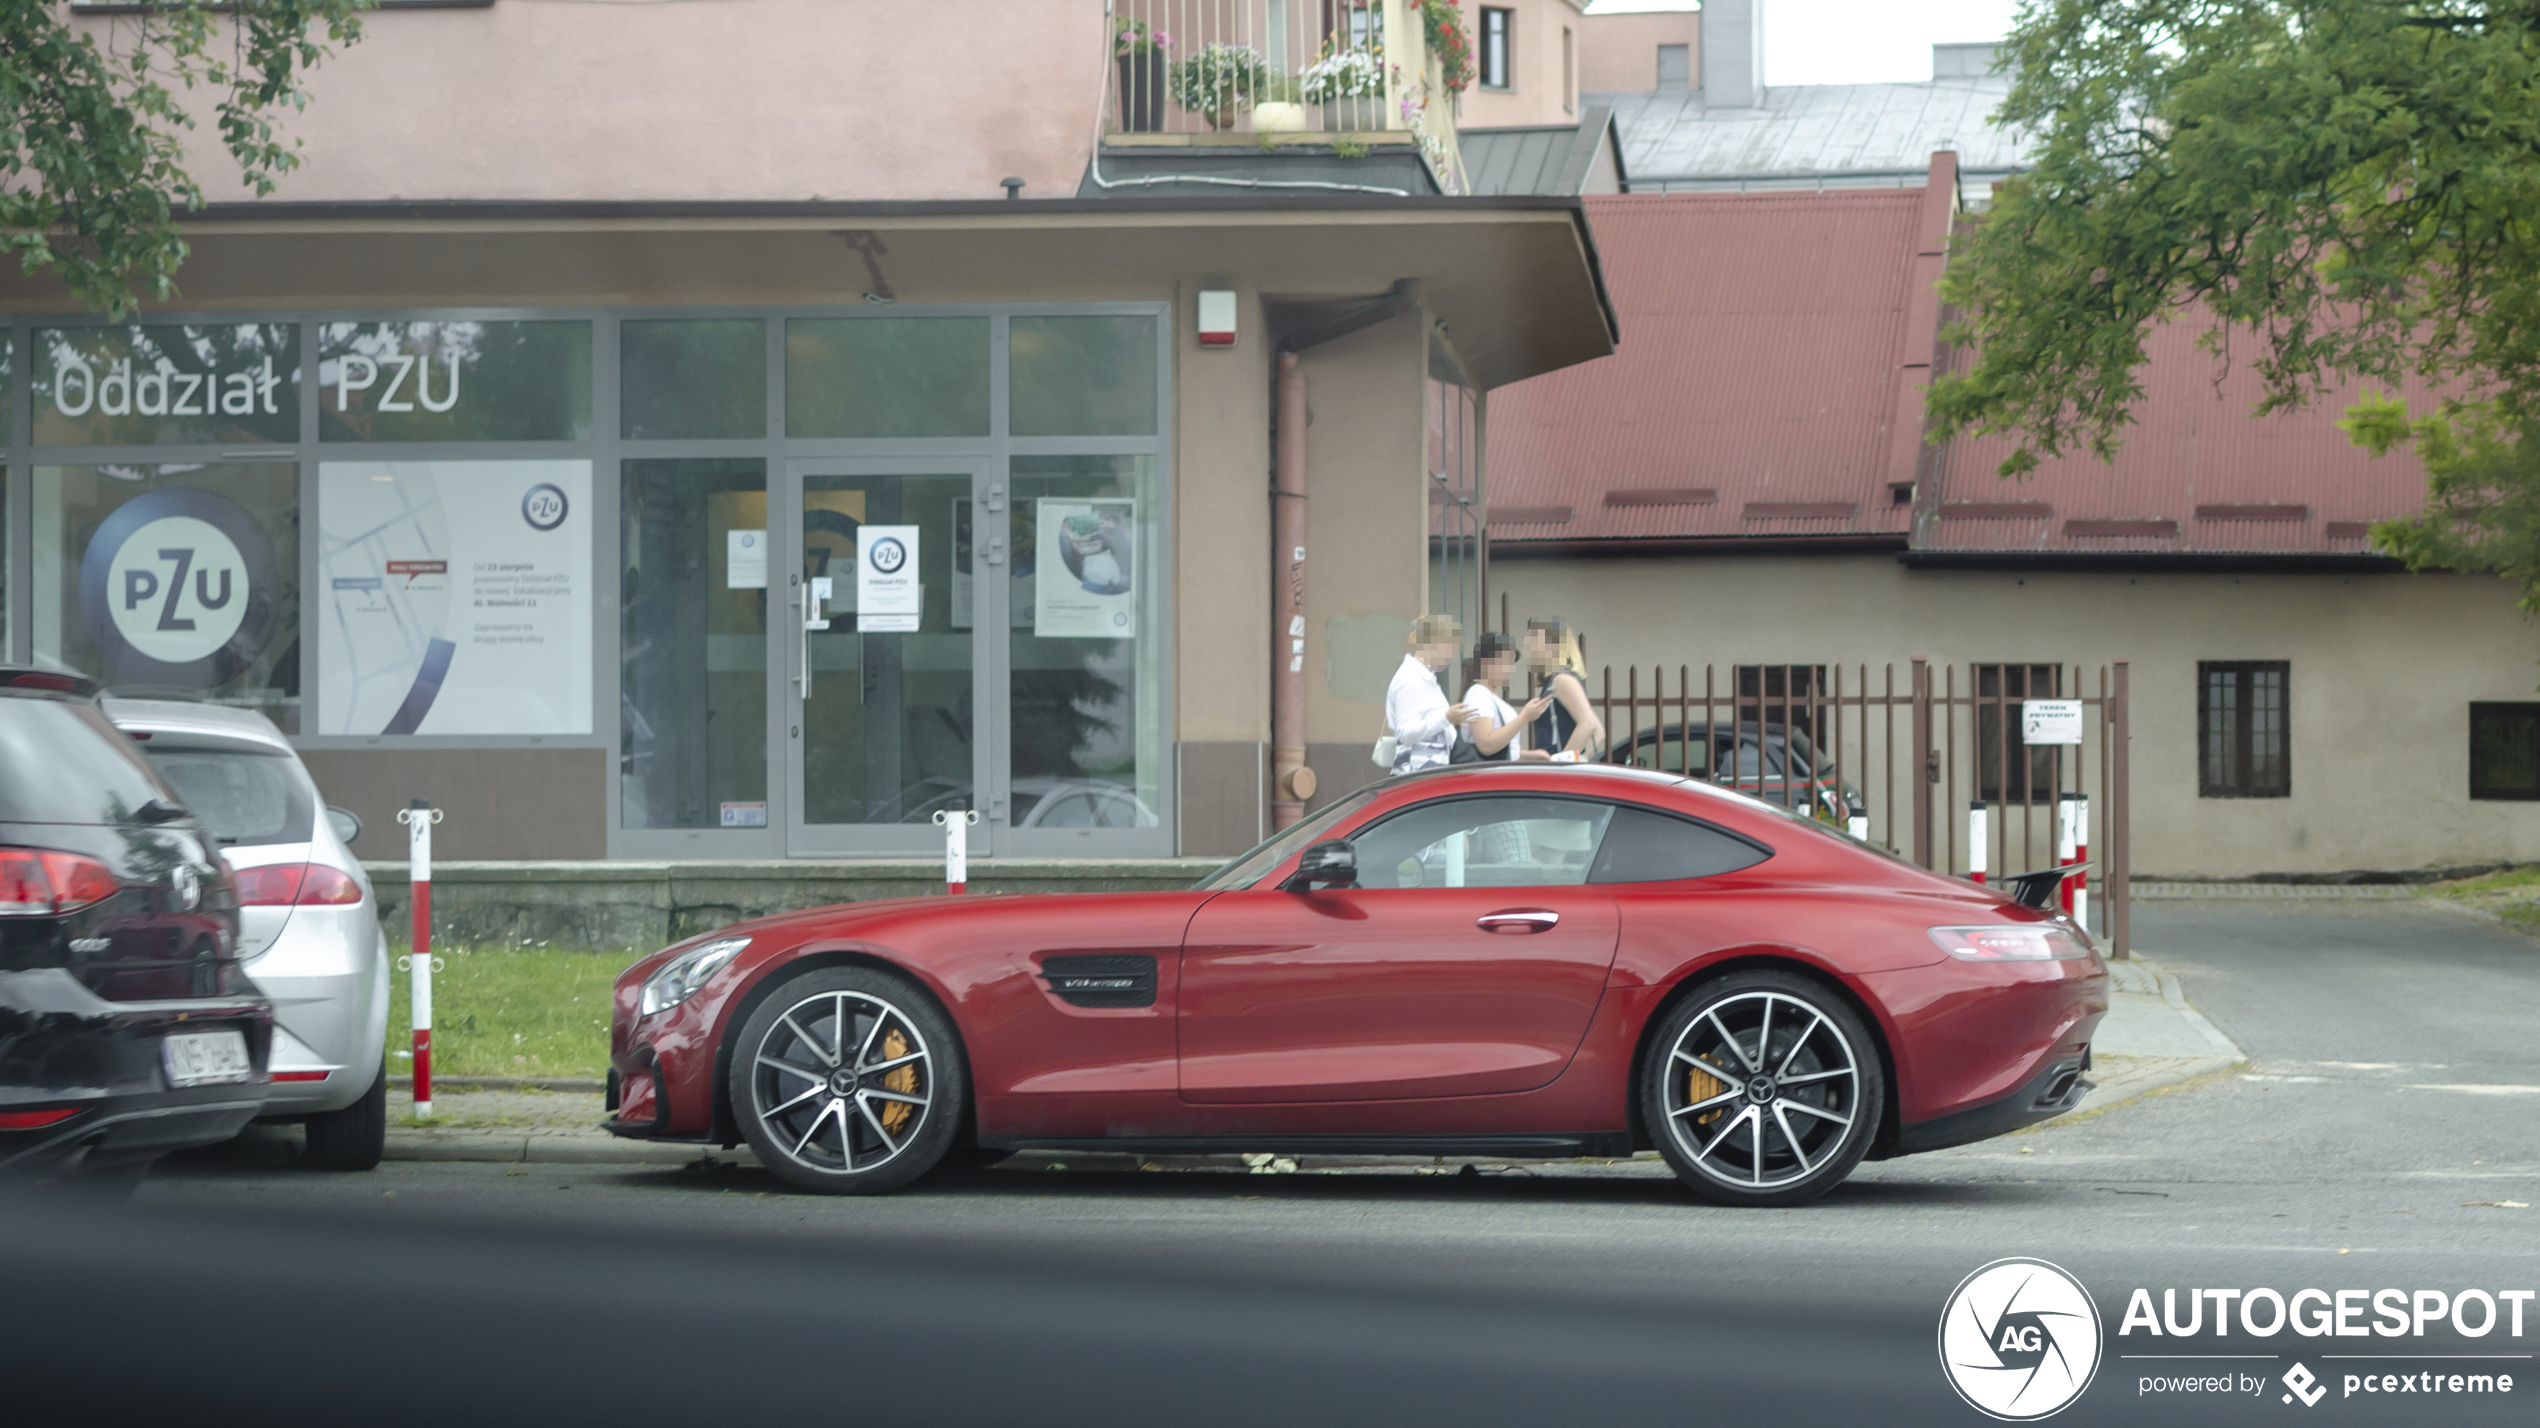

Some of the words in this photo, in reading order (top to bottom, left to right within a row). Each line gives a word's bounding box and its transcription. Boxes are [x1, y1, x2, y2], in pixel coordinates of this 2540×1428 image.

[54, 355, 282, 417] Oddział
[337, 354, 460, 413] PZU
[531, 497, 559, 518] PZU
[877, 547, 899, 565] PZU
[124, 547, 231, 632] PZU
